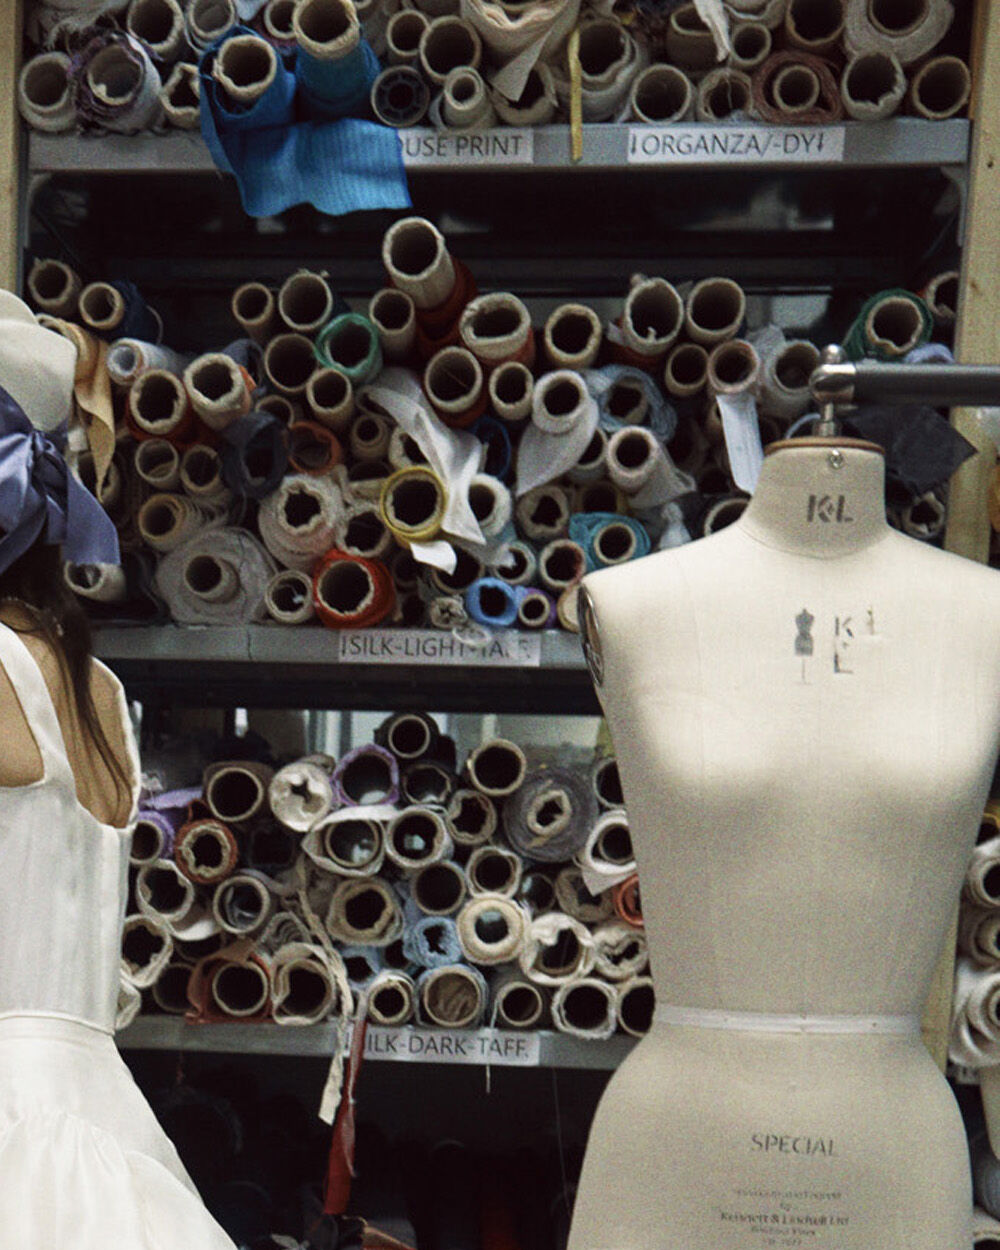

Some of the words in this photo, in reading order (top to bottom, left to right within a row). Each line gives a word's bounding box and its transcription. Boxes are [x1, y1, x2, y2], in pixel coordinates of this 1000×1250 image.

[401, 136, 448, 157] USE
[455, 135, 523, 157] PRINT
[367, 1034, 530, 1058] ILK-DARK-TAFF.
[751, 1133, 839, 1157] SPECIAL
